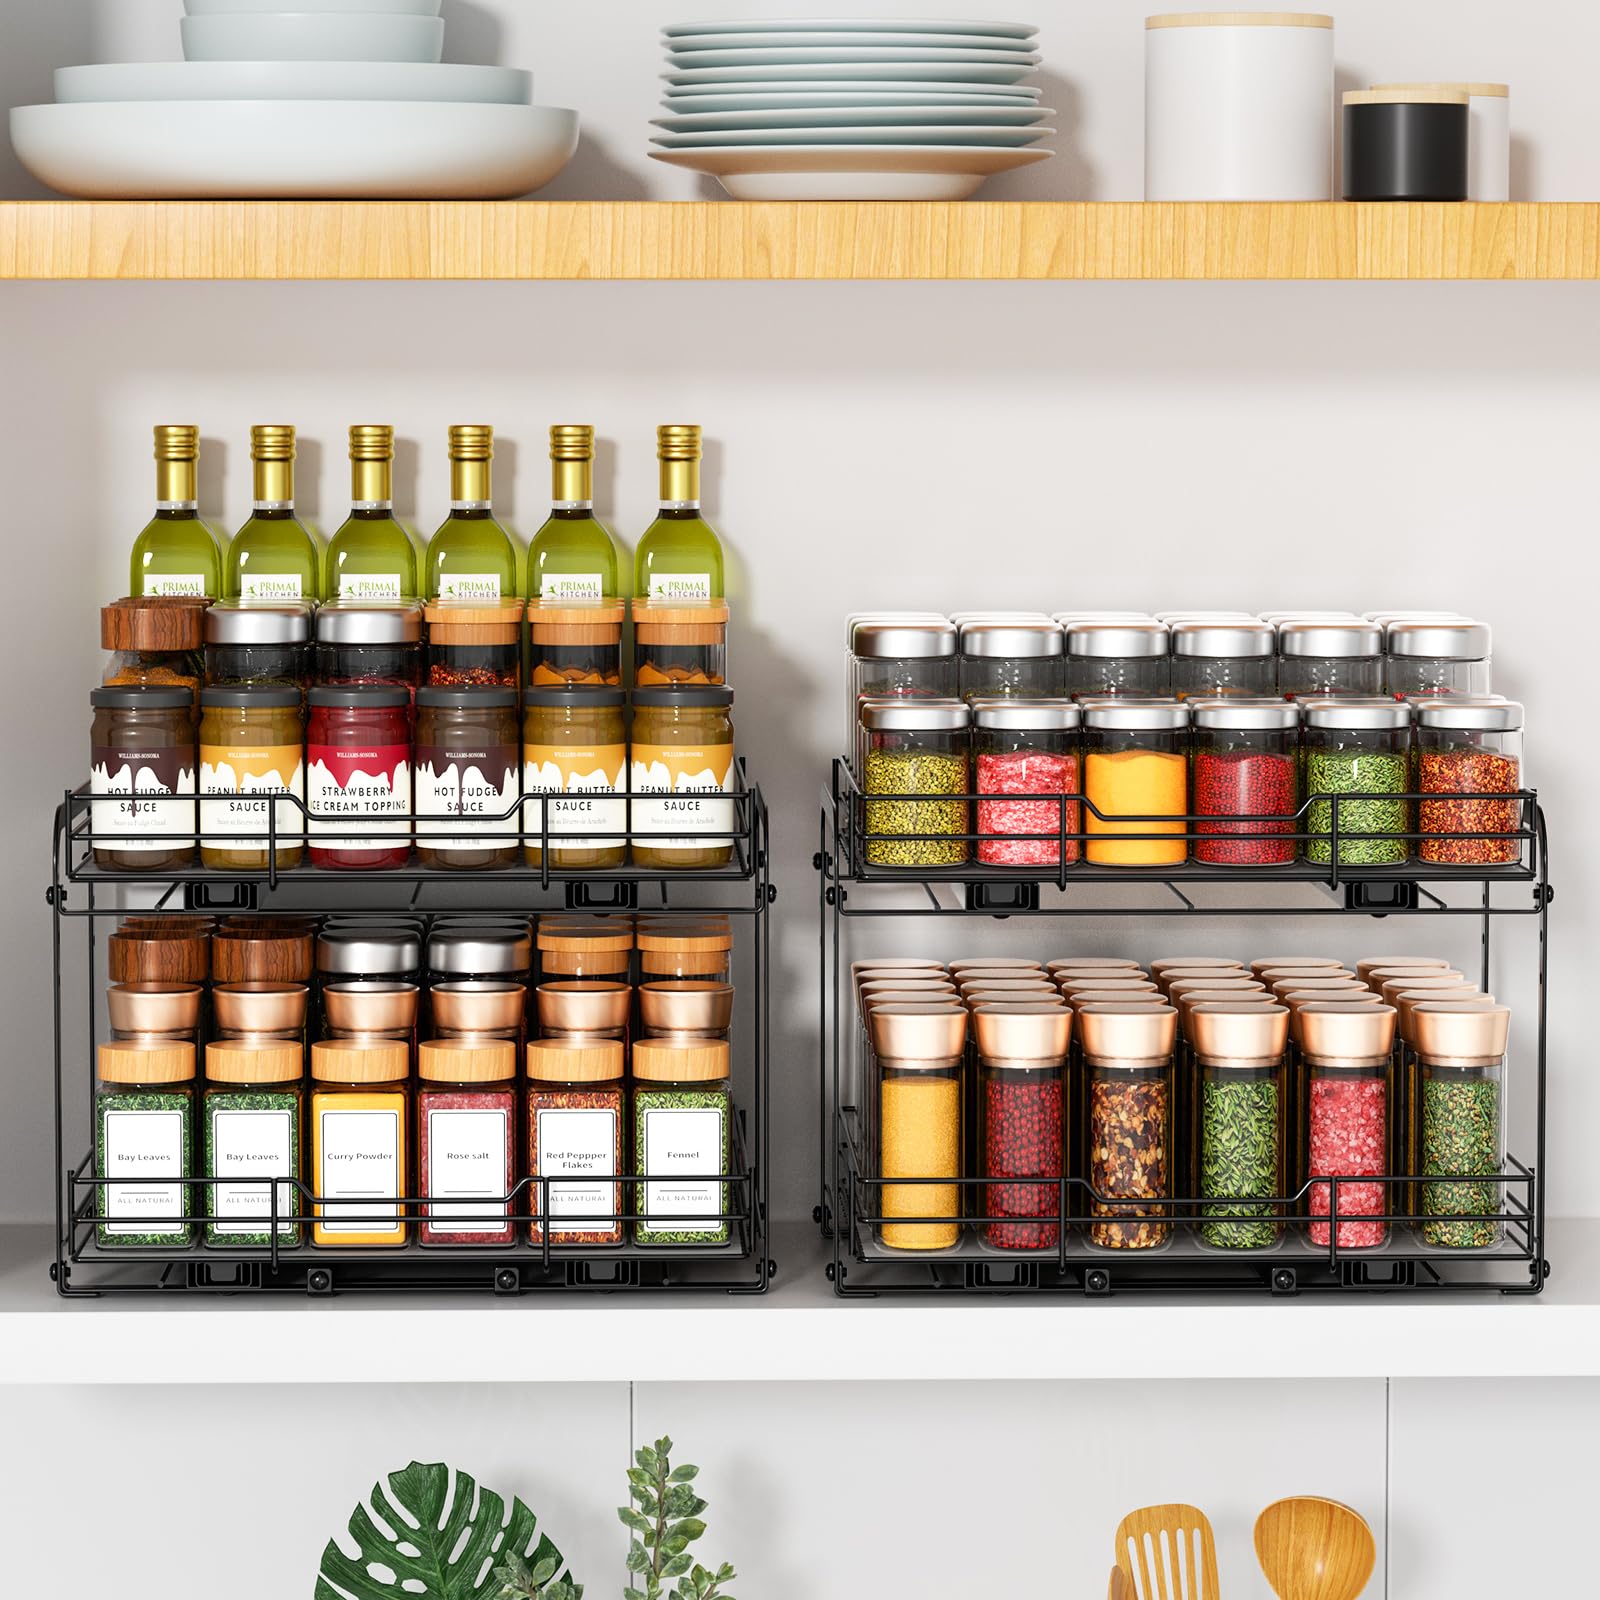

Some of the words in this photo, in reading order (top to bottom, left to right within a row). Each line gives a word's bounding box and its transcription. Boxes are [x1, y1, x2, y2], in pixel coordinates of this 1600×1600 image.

[163, 582, 200, 592] PRIMAL
[260, 582, 296, 591] PRIMAL
[359, 582, 395, 591] PRIMAL
[459, 582, 495, 591] PRIMAL
[560, 582, 597, 591] PRIMAL
[668, 582, 705, 591] PRIMAL
[108, 787, 129, 795] HOT
[135, 787, 170, 795] FUDGE
[208, 786, 246, 795] PEANUT
[252, 786, 291, 795] BUTTER
[322, 786, 391, 797] STRAWBERRY
[434, 787, 455, 797] HOT
[461, 787, 497, 797] FUDGE
[533, 785, 572, 794] PEANUT
[578, 785, 616, 794] BUTTER
[641, 785, 680, 793] PEANUT
[686, 785, 724, 793] BUTTER
[120, 803, 157, 813] SAUCE
[229, 802, 267, 812] SAUCE
[323, 801, 359, 811] CREAM
[364, 799, 406, 812] TOPPING
[447, 802, 484, 811] SAUCE
[555, 801, 592, 811] SAUCE
[664, 801, 701, 811] SAUCE
[118, 1154, 135, 1163] Bay
[226, 1153, 244, 1162] Bay
[247, 1153, 280, 1161] Leaves
[328, 1153, 354, 1161] Curry
[356, 1152, 393, 1160] Powder
[472, 1152, 490, 1160] salt
[546, 1152, 565, 1160] Red
[567, 1152, 607, 1161] Peppper
[667, 1151, 700, 1159] Fennel
[550, 1195, 564, 1203] ALL
